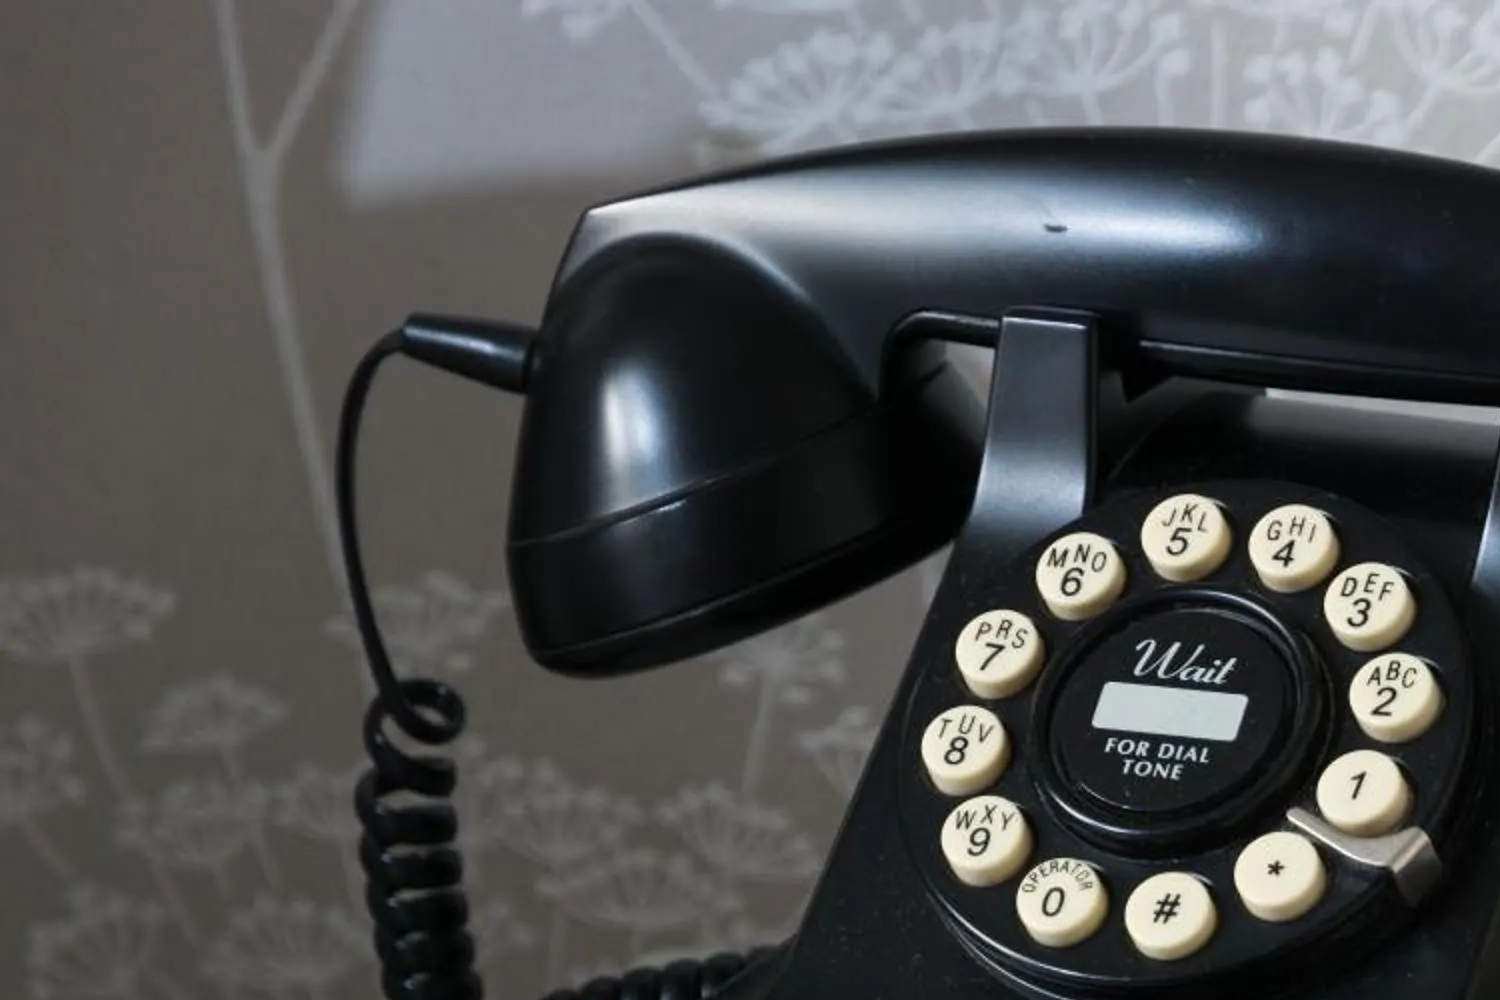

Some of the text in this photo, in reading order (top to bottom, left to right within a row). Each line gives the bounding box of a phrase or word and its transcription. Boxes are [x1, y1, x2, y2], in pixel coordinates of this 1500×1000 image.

[1162, 503, 1208, 532] JKL
[1267, 516, 1317, 545] GHI
[1165, 526, 1192, 557] 5
[1272, 539, 1296, 568] 4
[1047, 543, 1108, 573] MNO
[1060, 566, 1085, 597] 6
[1340, 572, 1396, 601] DEF
[1346, 597, 1372, 628] 3
[975, 619, 1028, 649] PRS
[979, 642, 1006, 671] 7
[1133, 638, 1237, 685] Wait
[1367, 660, 1418, 689] ABC
[1370, 686, 1397, 717] 2
[939, 714, 994, 743] TUV
[943, 735, 969, 766] 8
[1104, 737, 1209, 763] FOR DIAL
[1122, 759, 1184, 781] TONE
[1350, 771, 1368, 800] 1
[955, 805, 1014, 832] WXY
[967, 827, 991, 857] 9
[1021, 859, 1094, 893] OPERATOR
